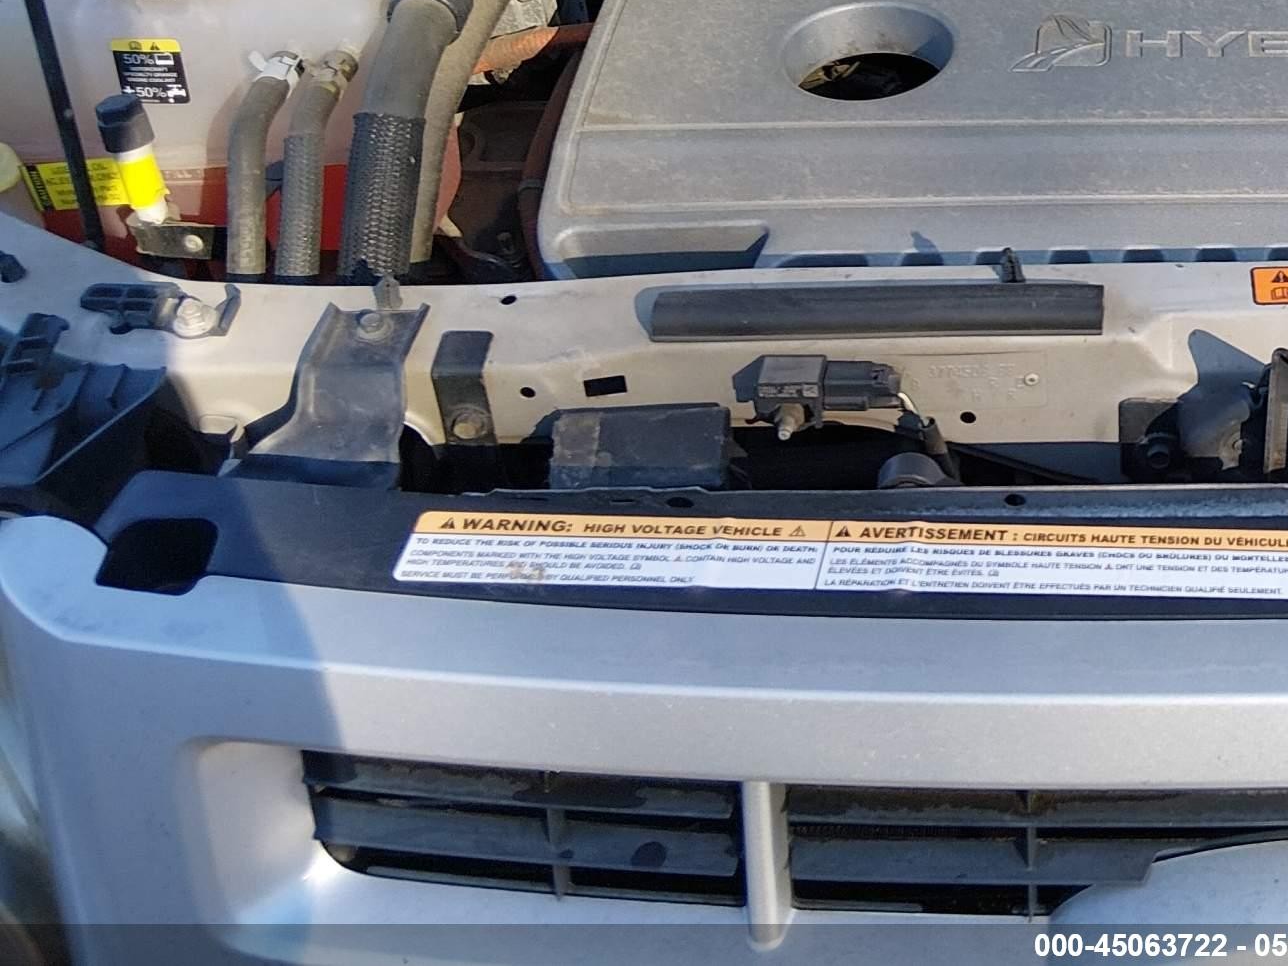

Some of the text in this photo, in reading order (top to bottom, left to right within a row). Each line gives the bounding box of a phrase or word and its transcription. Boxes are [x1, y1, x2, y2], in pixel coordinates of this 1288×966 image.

[123, 54, 154, 64] 50%
[463, 518, 782, 536] WARNING: HIGH VOLTAGE VEHICLE
[860, 526, 1008, 540] AVERTISSEMENT
[1023, 533, 1086, 542] CIRCUITS
[1091, 534, 1136, 543] HAUTE
[1141, 536, 1199, 545] TENSION
[1204, 537, 1222, 545] DU
